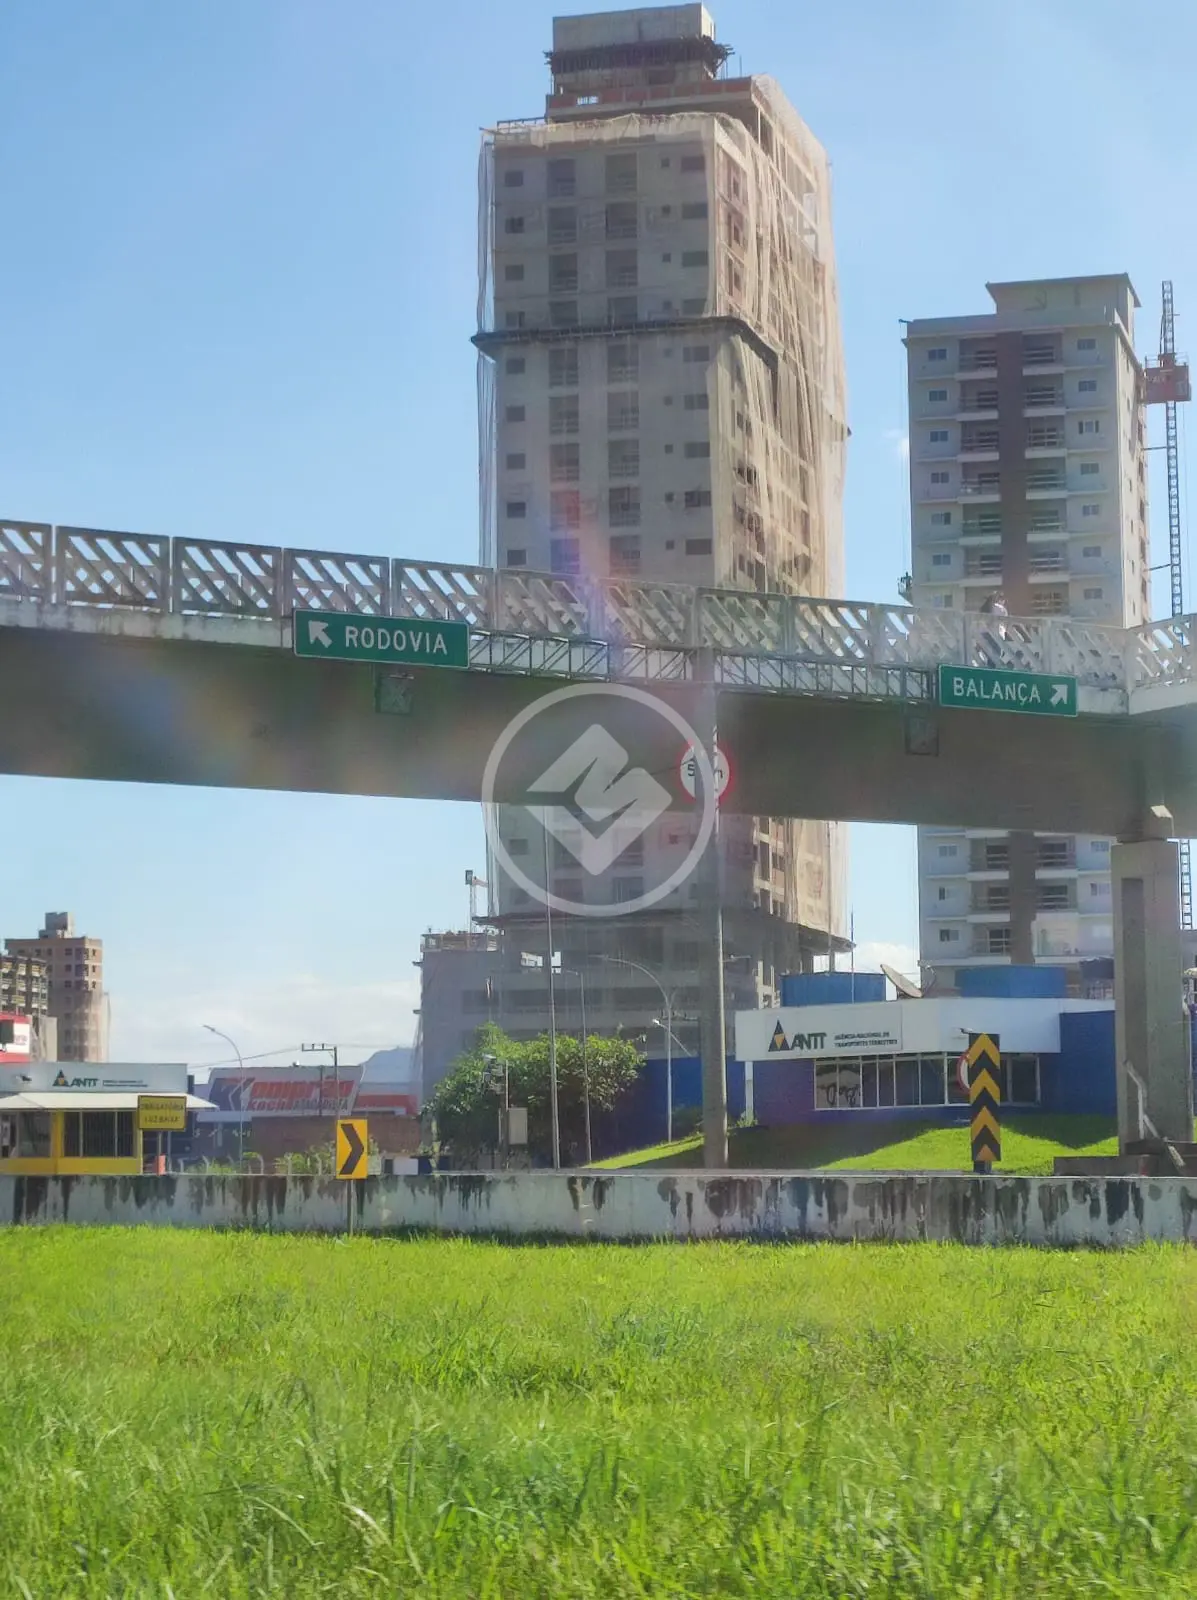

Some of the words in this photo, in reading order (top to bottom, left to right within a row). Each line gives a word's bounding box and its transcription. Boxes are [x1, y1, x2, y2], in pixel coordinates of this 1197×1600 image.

[345, 625, 448, 656] RODOVIA
[953, 677, 1041, 706] BALANÇA
[790, 1032, 828, 1051] ANTT
[69, 1077, 99, 1088] ANTT
